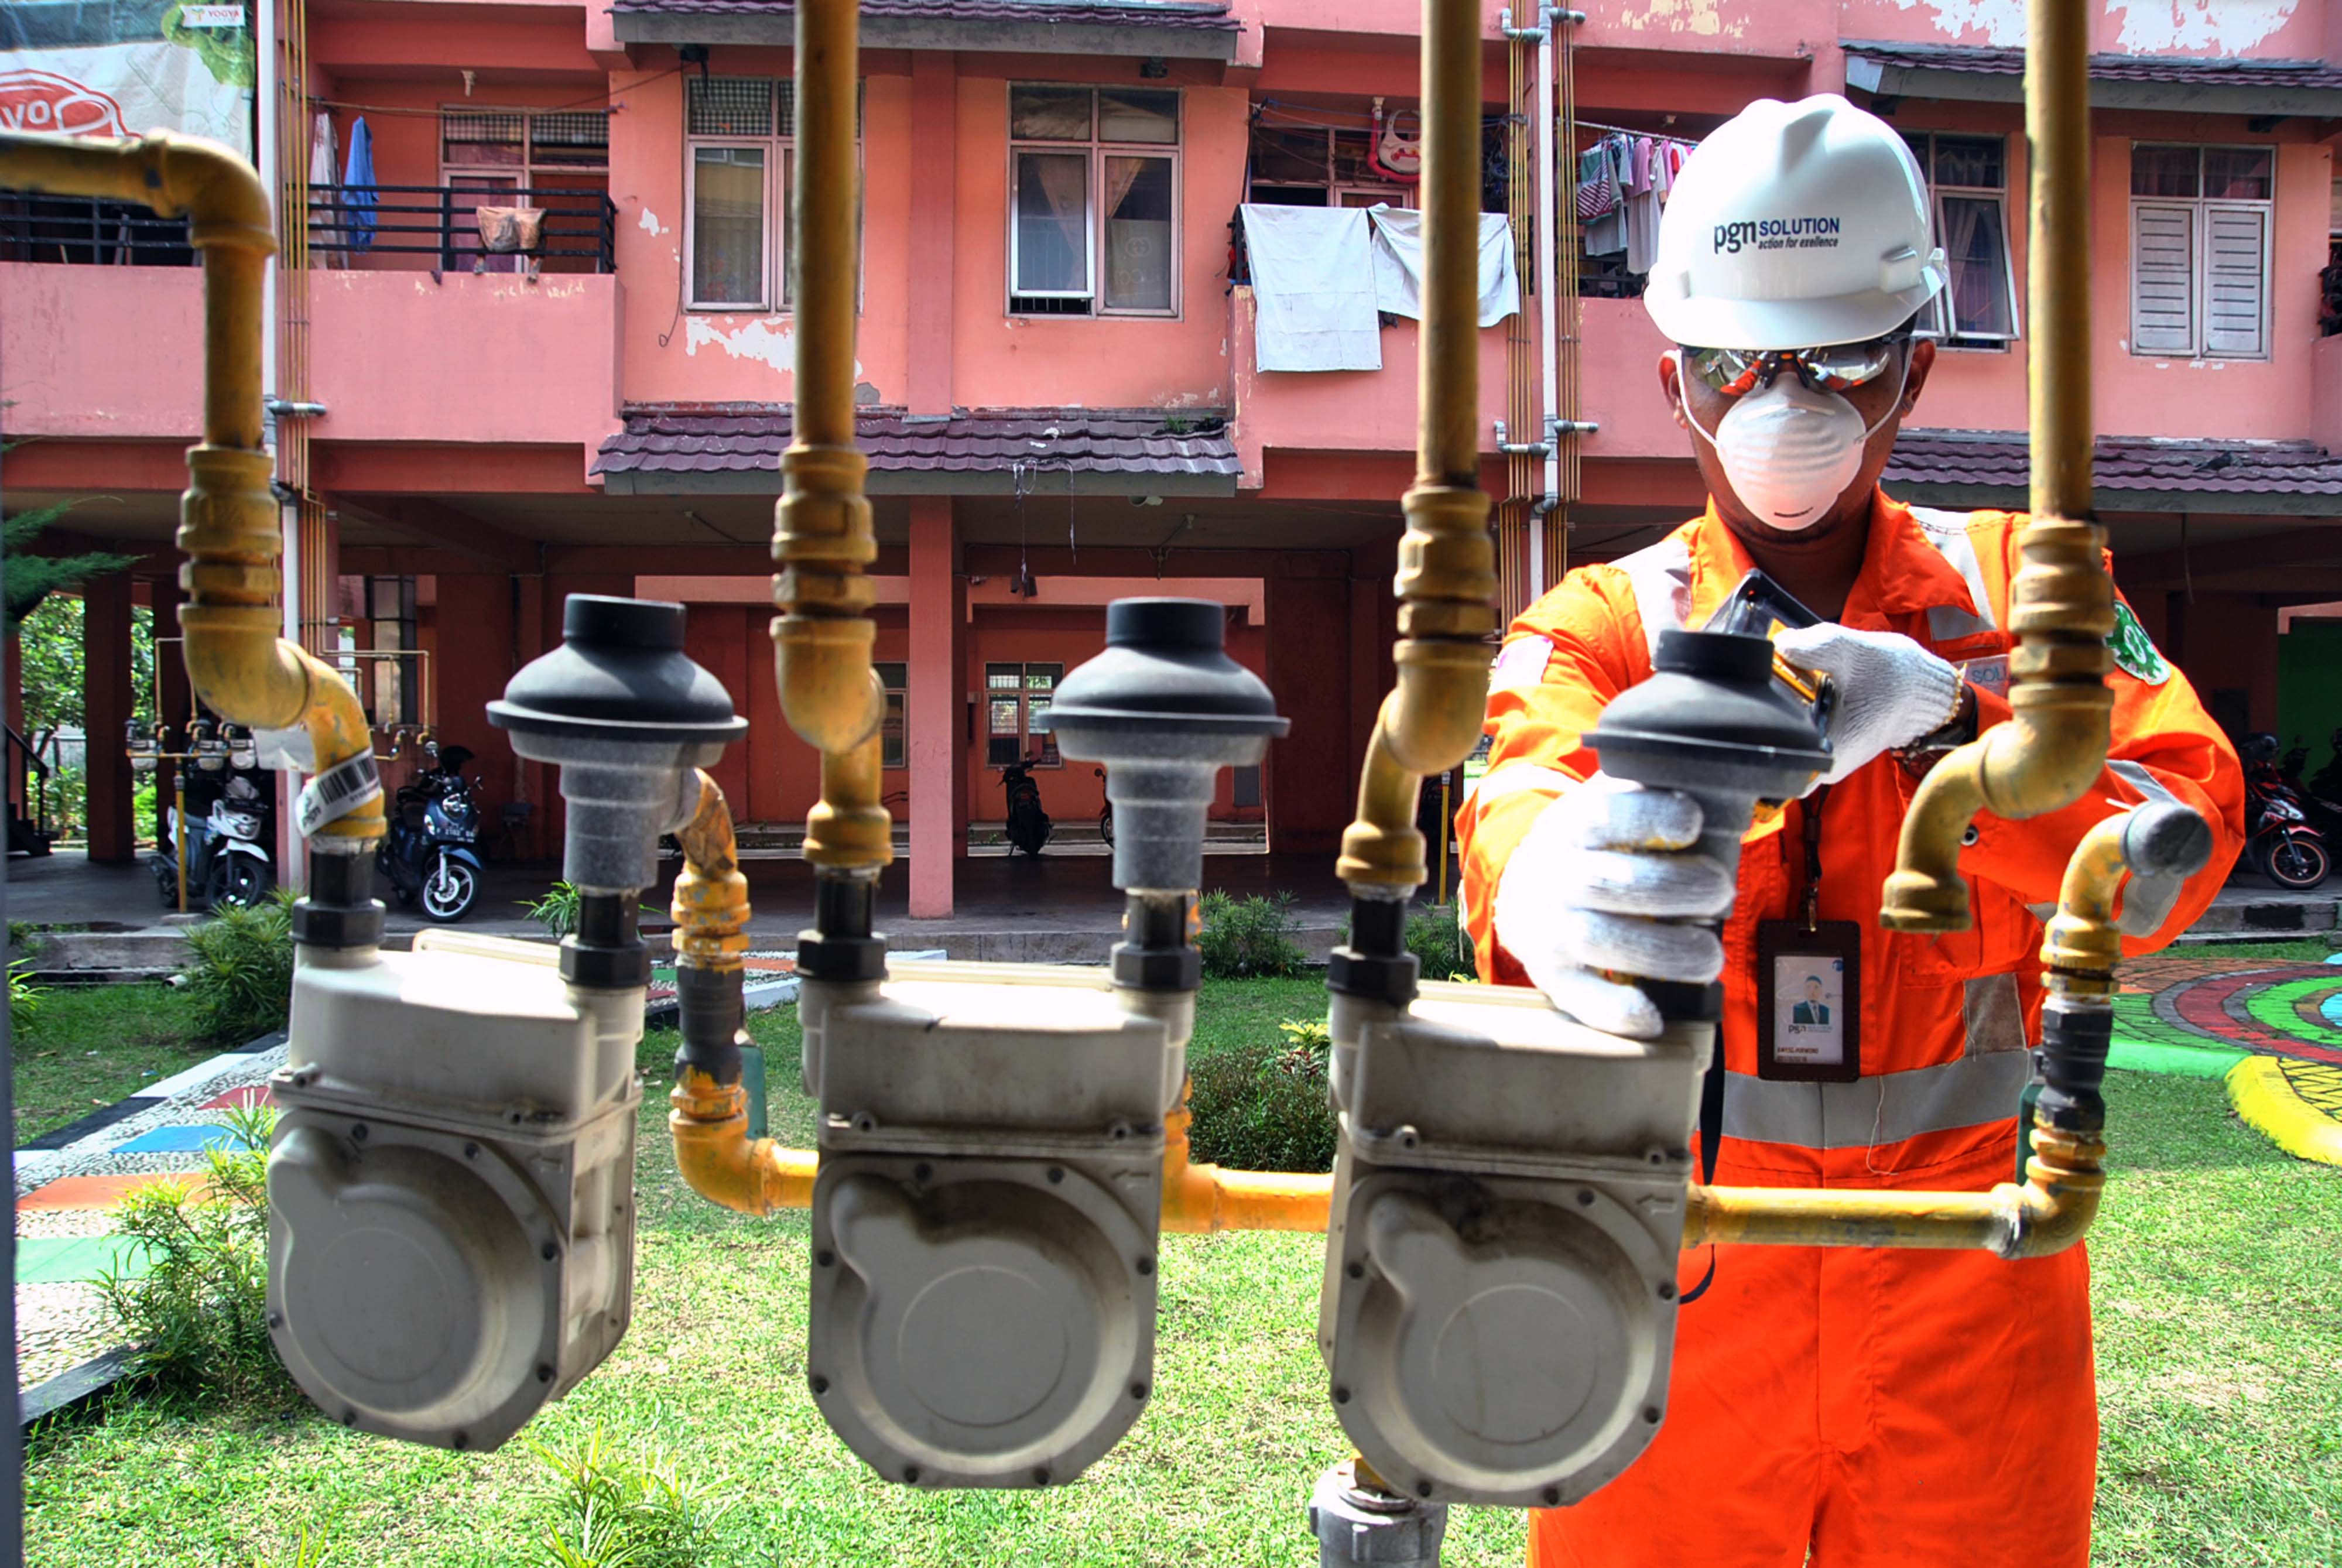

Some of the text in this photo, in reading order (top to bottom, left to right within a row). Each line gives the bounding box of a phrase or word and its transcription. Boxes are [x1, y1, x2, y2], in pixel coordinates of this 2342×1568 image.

[1714, 217, 1840, 254] pgn SOLUTION
[1758, 235, 1838, 250] action for exellence
